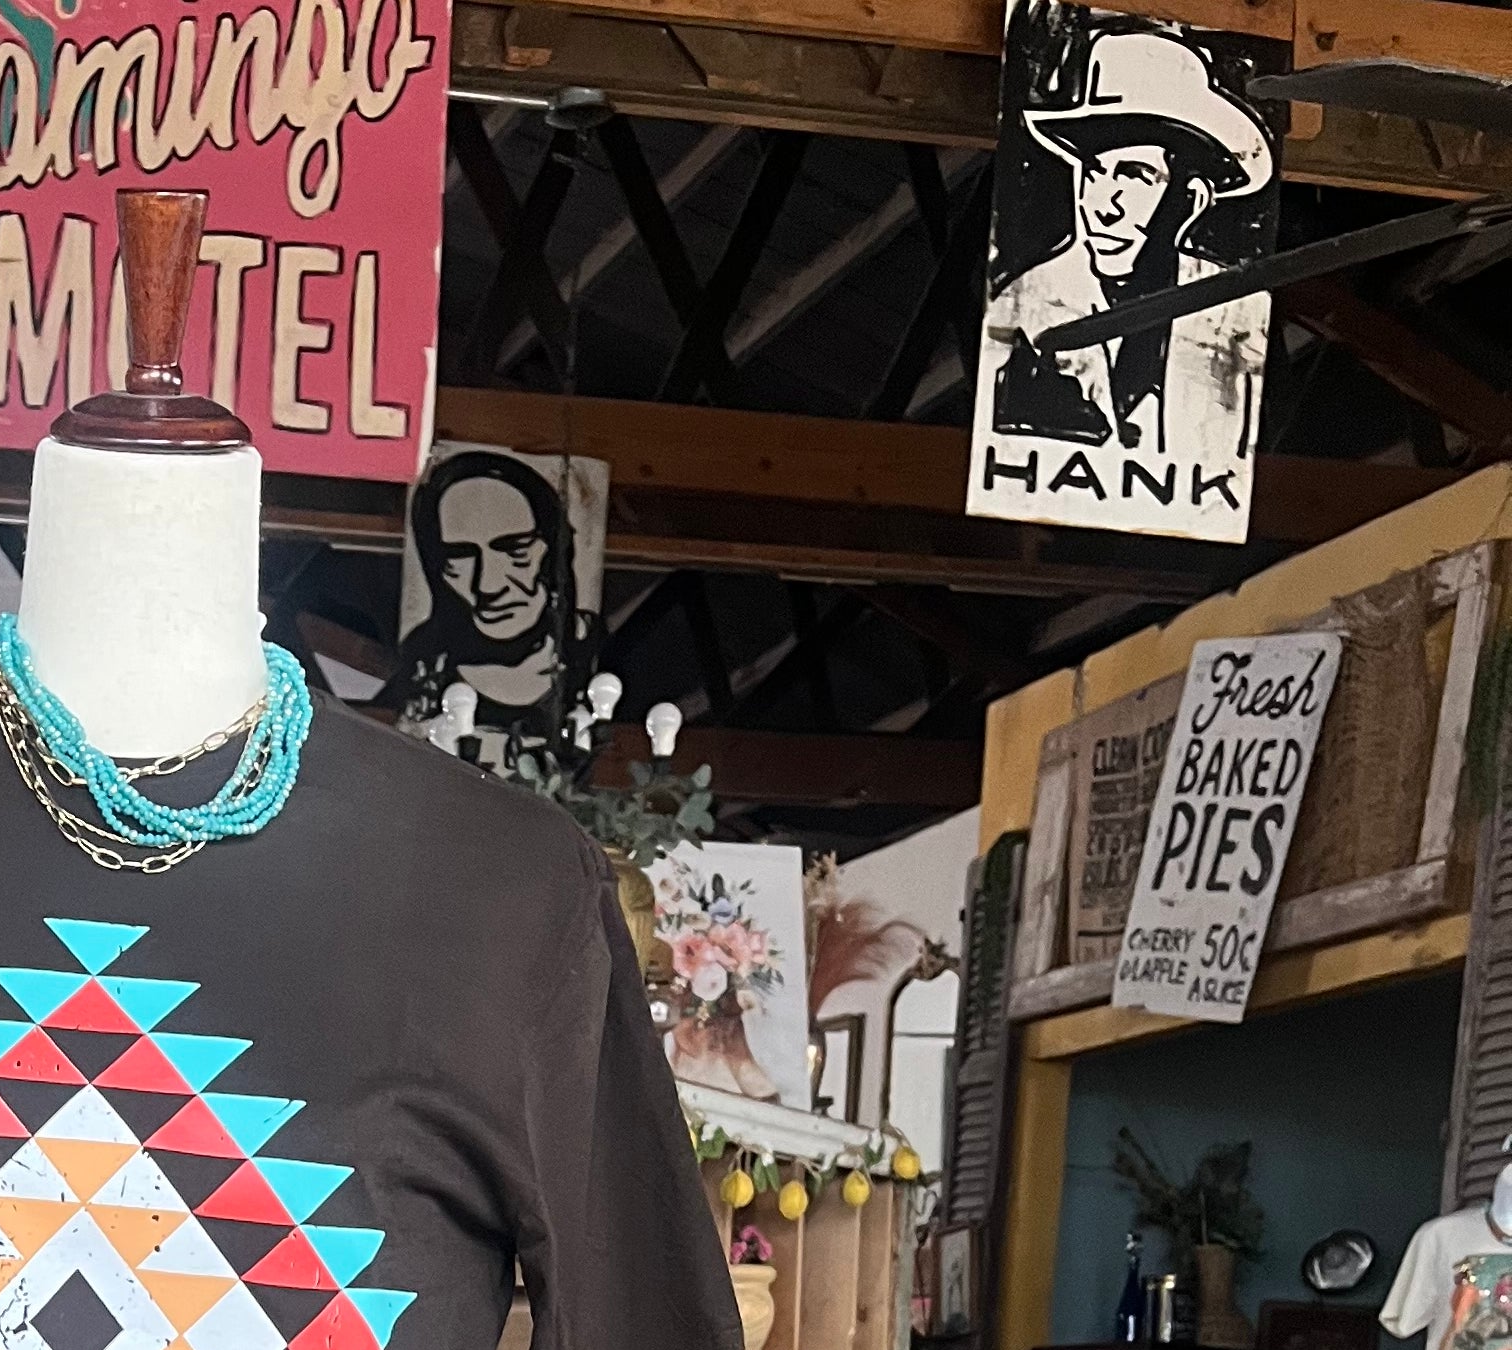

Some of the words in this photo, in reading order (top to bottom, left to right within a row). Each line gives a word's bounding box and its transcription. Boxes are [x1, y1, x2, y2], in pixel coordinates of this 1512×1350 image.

[983, 444, 1241, 511] HANK
[1191, 649, 1328, 734] Fresh
[1175, 738, 1303, 797] BAKED
[1151, 801, 1286, 897] PIES
